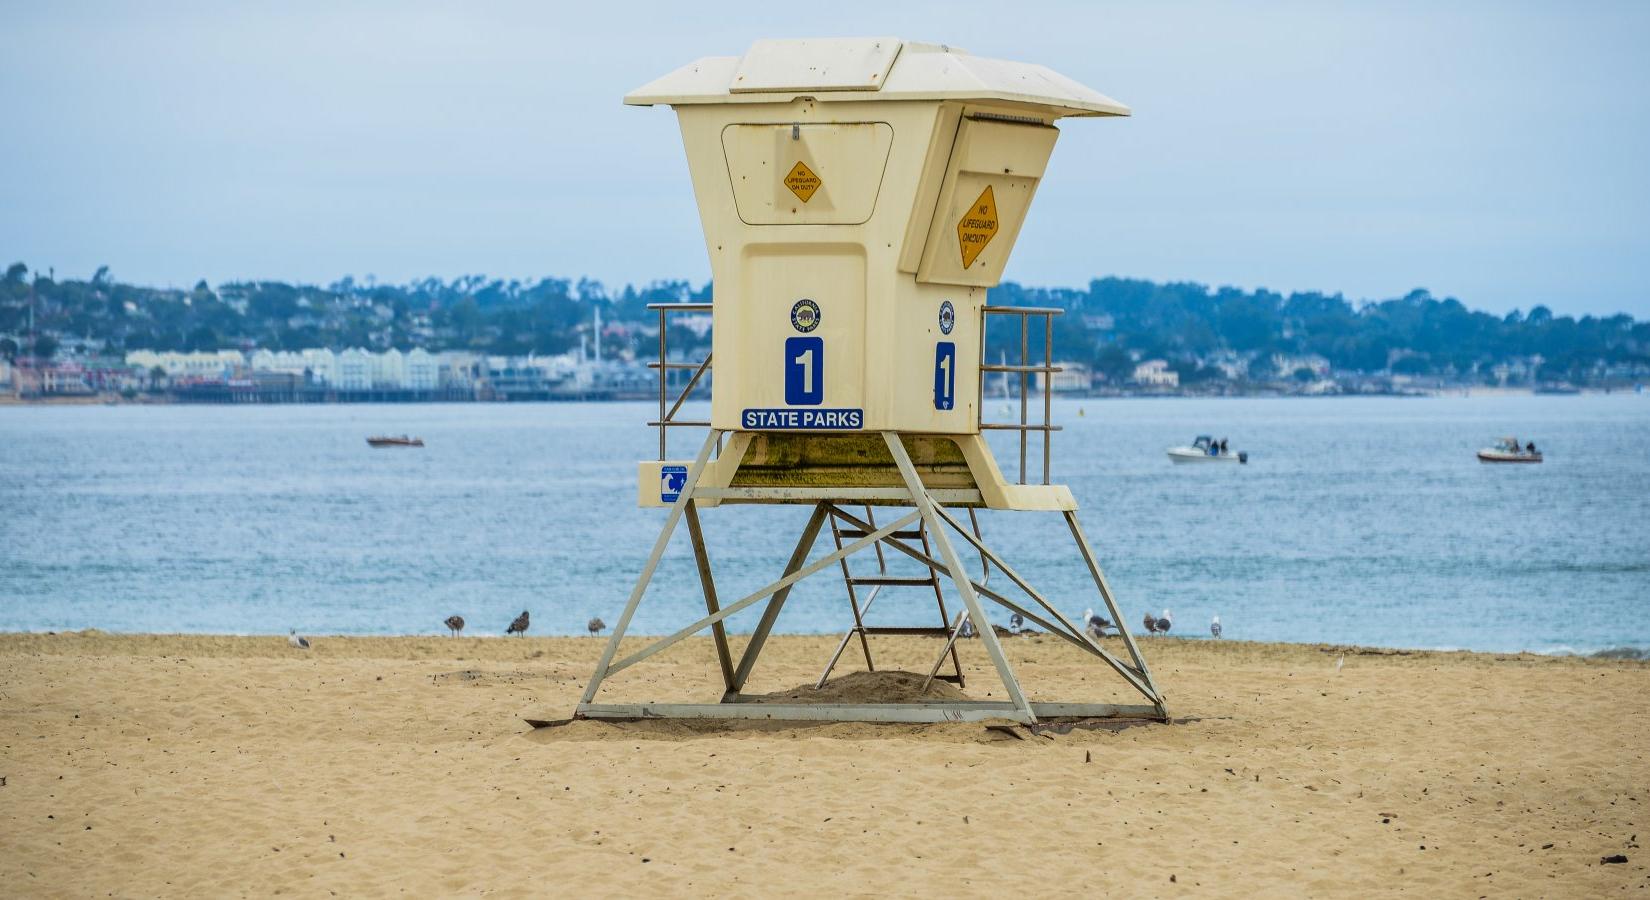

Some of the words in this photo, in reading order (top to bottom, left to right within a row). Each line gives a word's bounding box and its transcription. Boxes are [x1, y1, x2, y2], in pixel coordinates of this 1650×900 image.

[978, 205, 988, 215] NO
[963, 219, 995, 230] LIFEGUARD
[796, 350, 813, 393] 1
[940, 354, 950, 398] 1
[746, 412, 799, 427] STATE
[803, 412, 860, 427] PARKS
